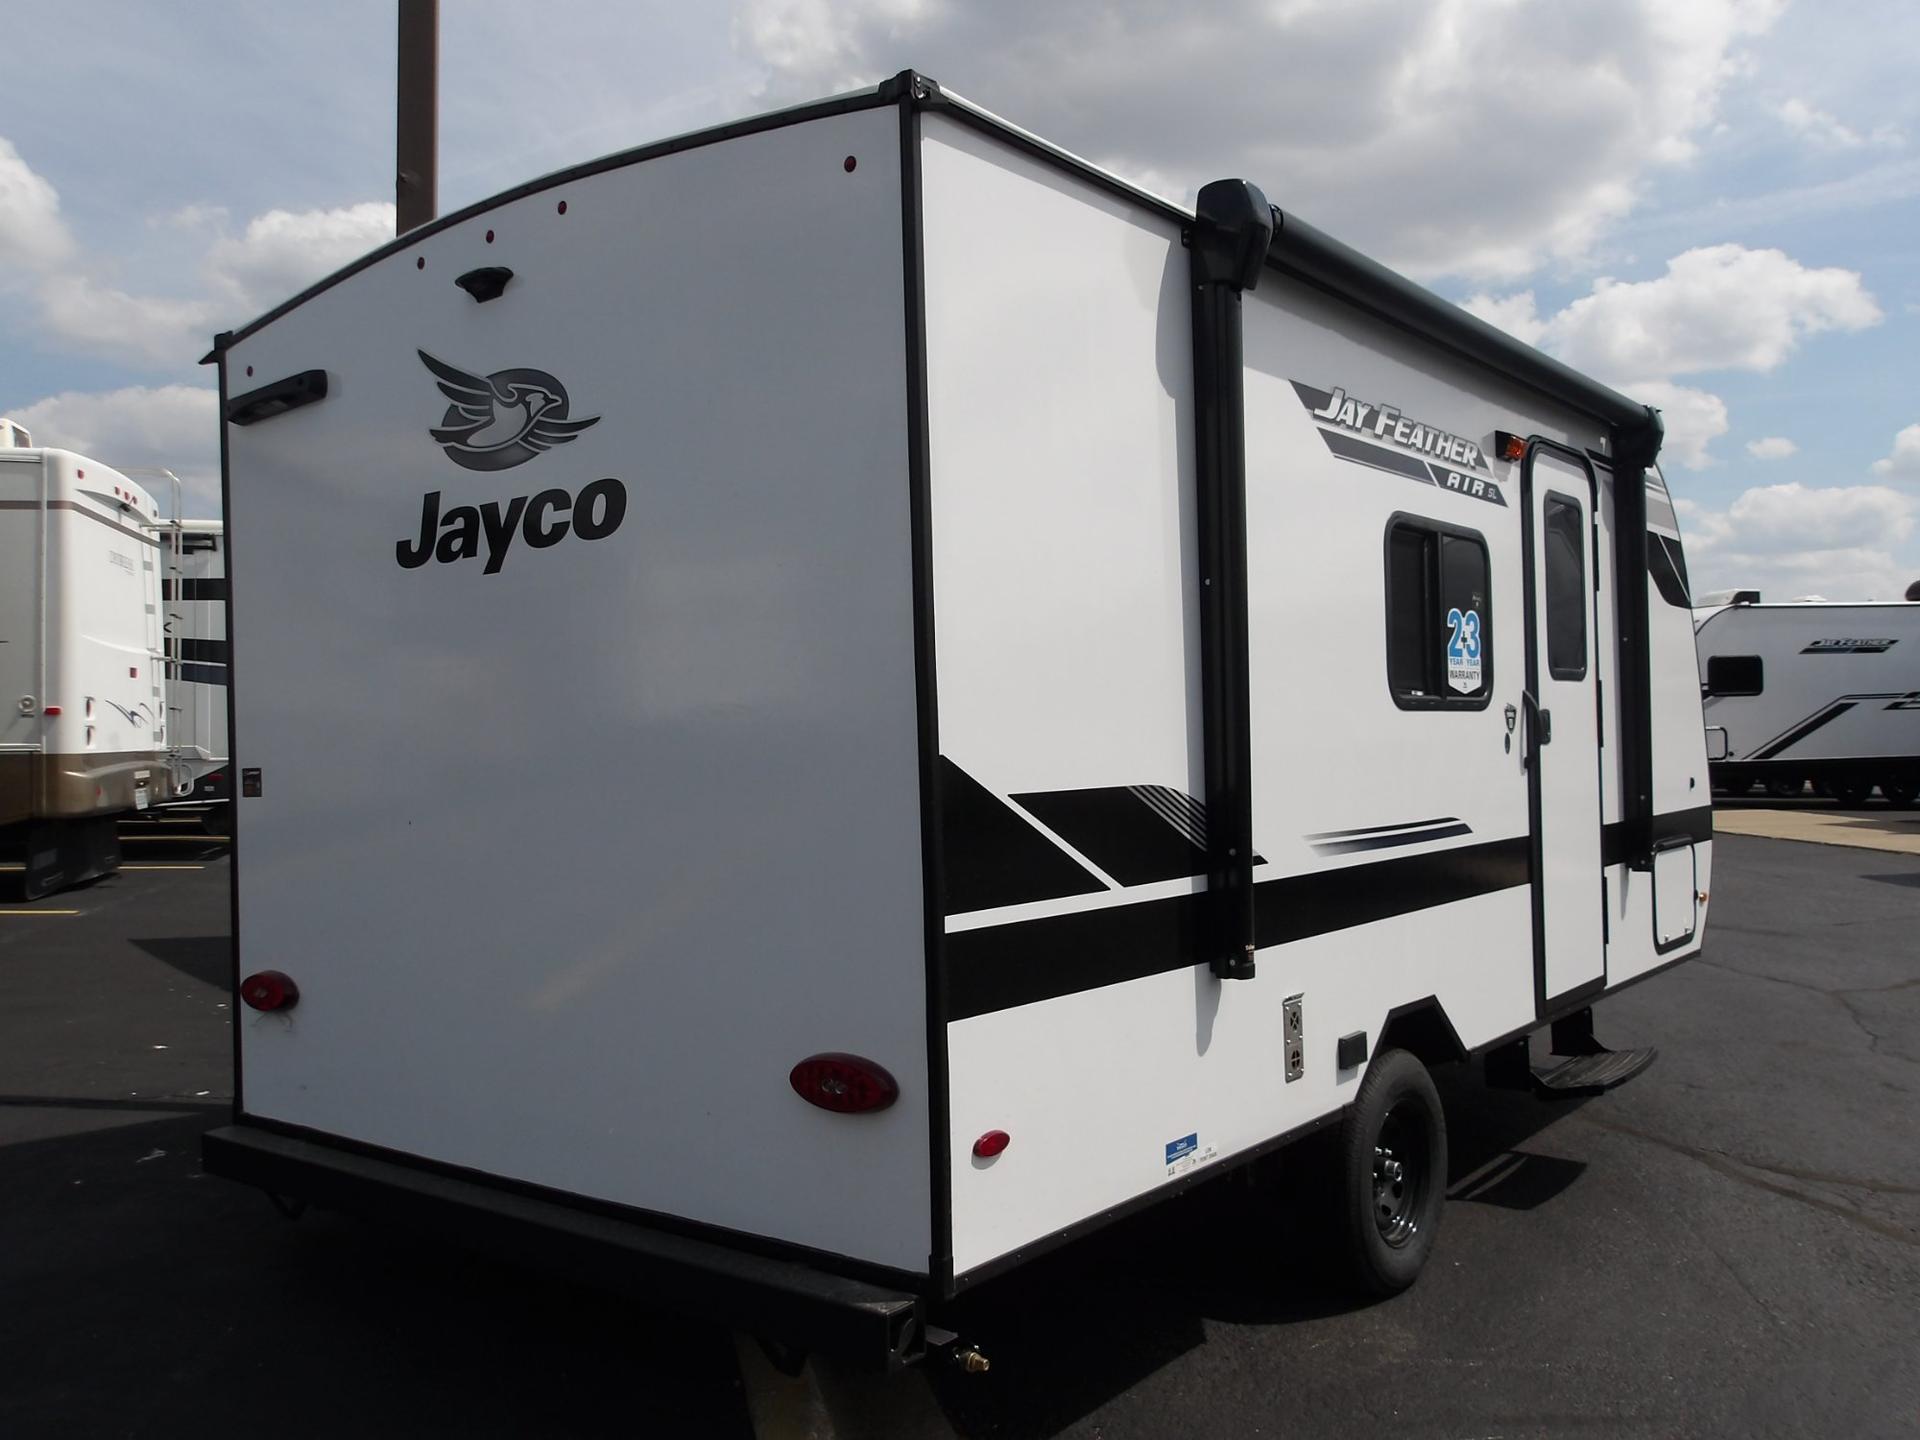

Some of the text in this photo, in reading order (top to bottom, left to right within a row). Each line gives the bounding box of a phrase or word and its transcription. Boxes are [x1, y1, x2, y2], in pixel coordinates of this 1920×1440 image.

[1313, 386, 1480, 470] JAY FEATHER
[1447, 472, 1485, 496] AIR
[396, 478, 627, 575] Jayco
[1449, 658, 1480, 667] YEAR YEAR
[1449, 670, 1480, 681] WARRANTY
